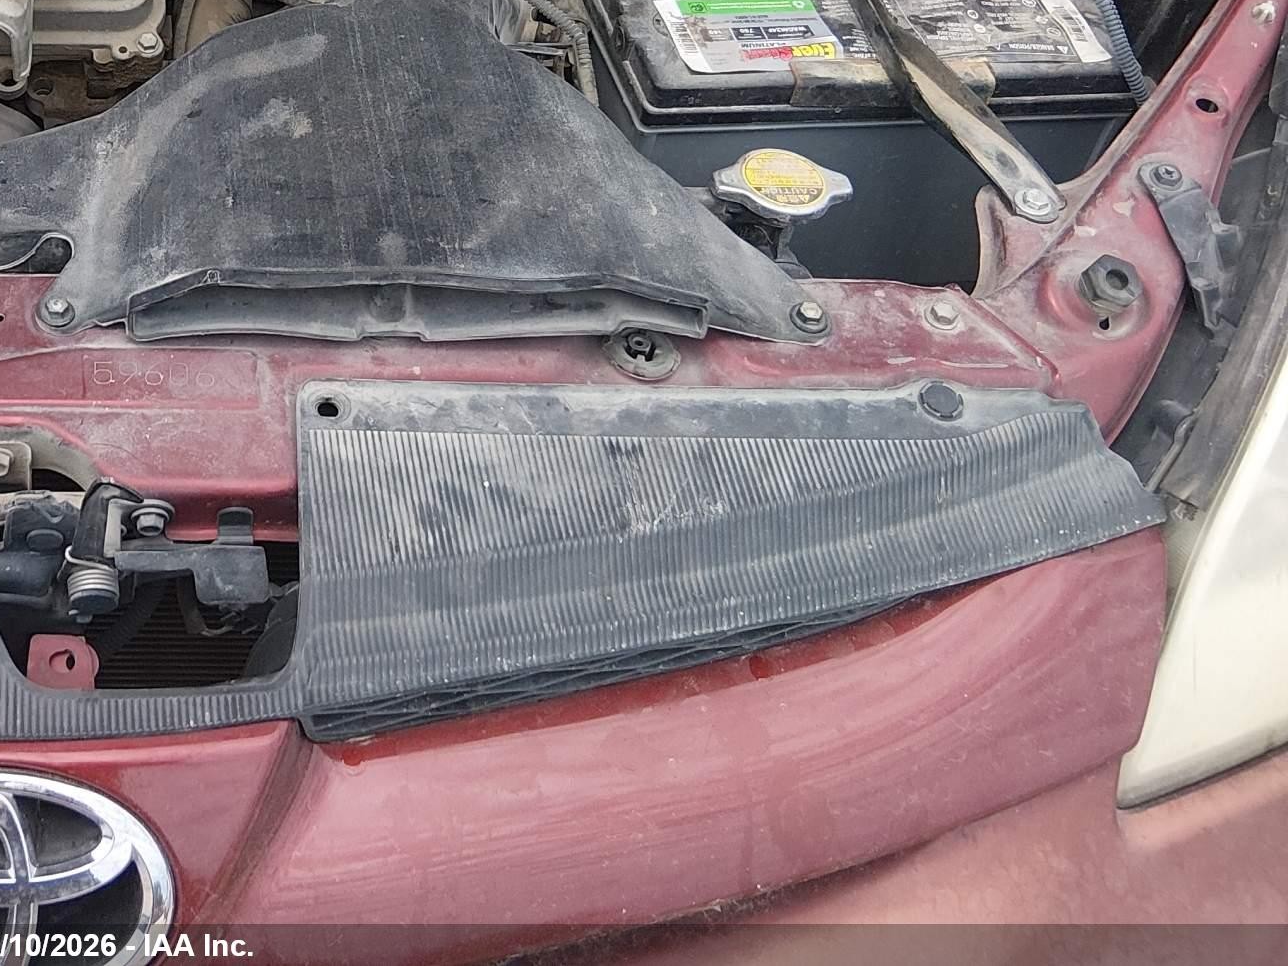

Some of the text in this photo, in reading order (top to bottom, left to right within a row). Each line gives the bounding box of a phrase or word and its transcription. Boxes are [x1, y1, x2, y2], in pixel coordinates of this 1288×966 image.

[741, 41, 786, 49] PLATINUM
[760, 187, 818, 195] CAUTION
[92, 361, 215, 387] 59606
